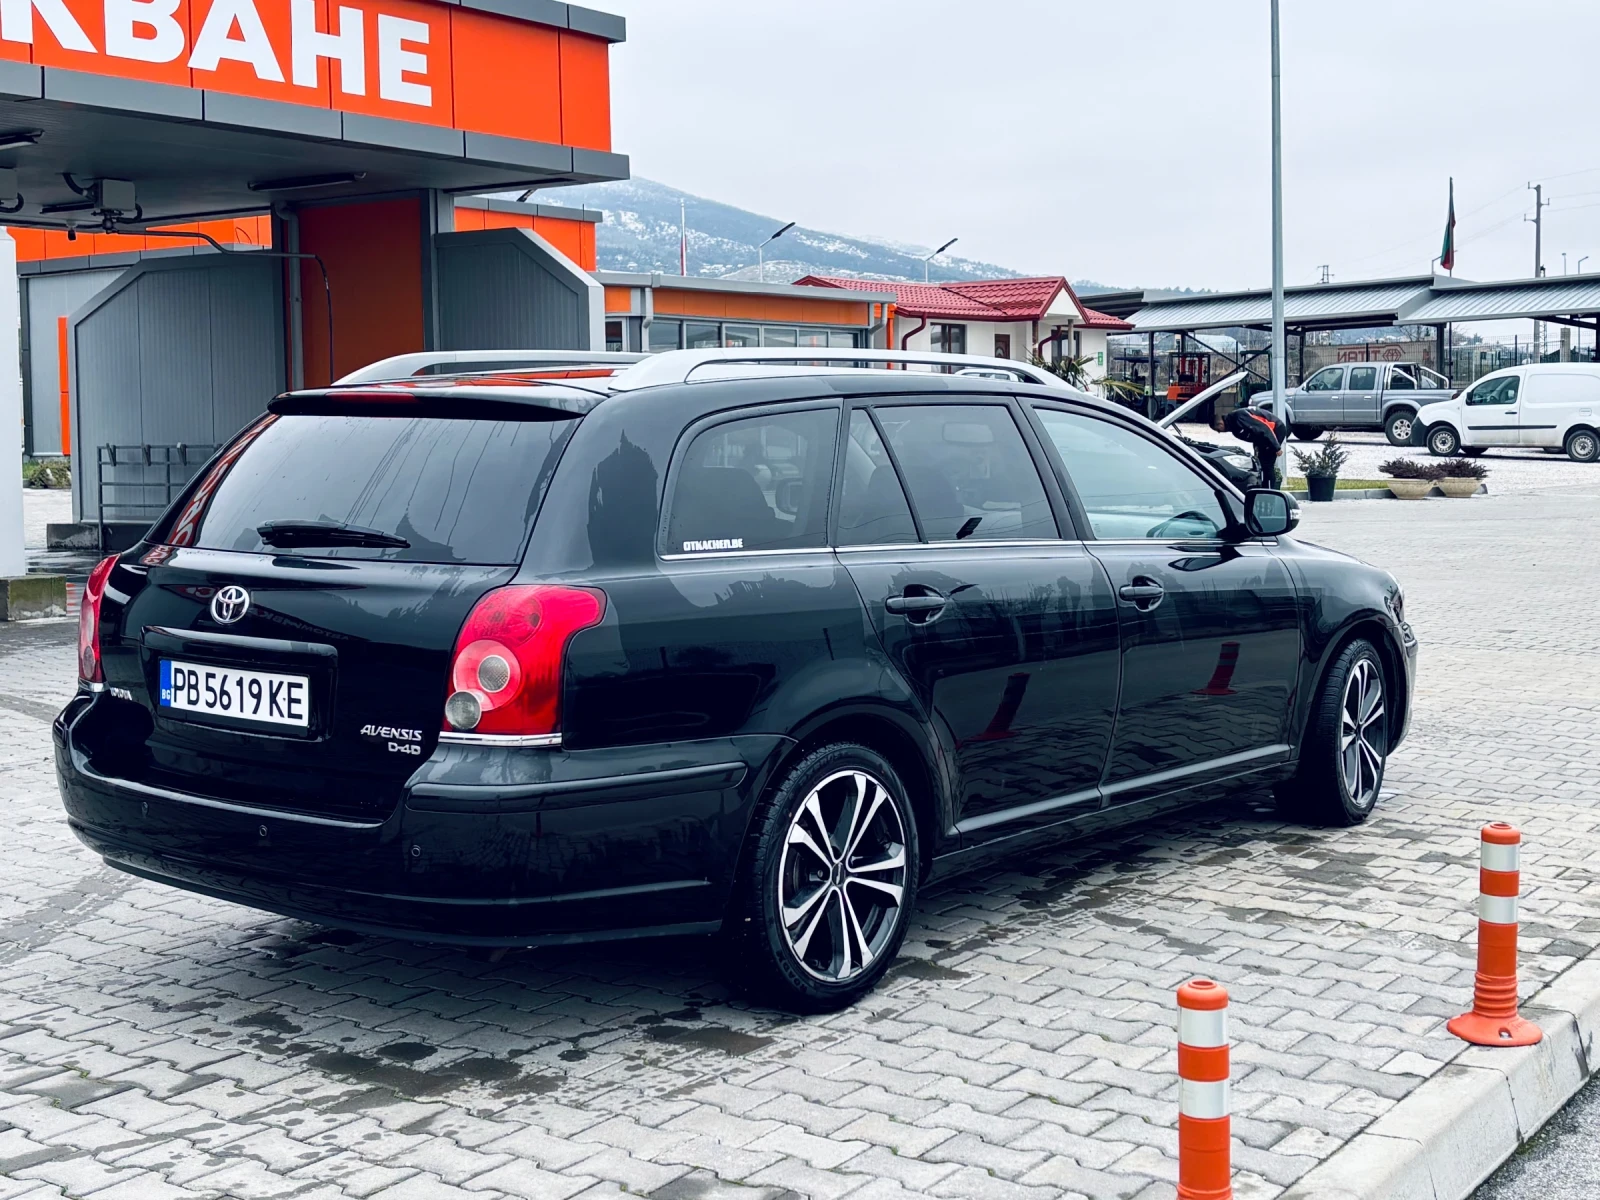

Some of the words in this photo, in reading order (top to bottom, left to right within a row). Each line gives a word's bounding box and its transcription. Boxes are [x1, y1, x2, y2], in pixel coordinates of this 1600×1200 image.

[161, 688, 171, 700] BG
[360, 724, 422, 741] AVENSIS
[387, 742, 421, 755] D-4D
